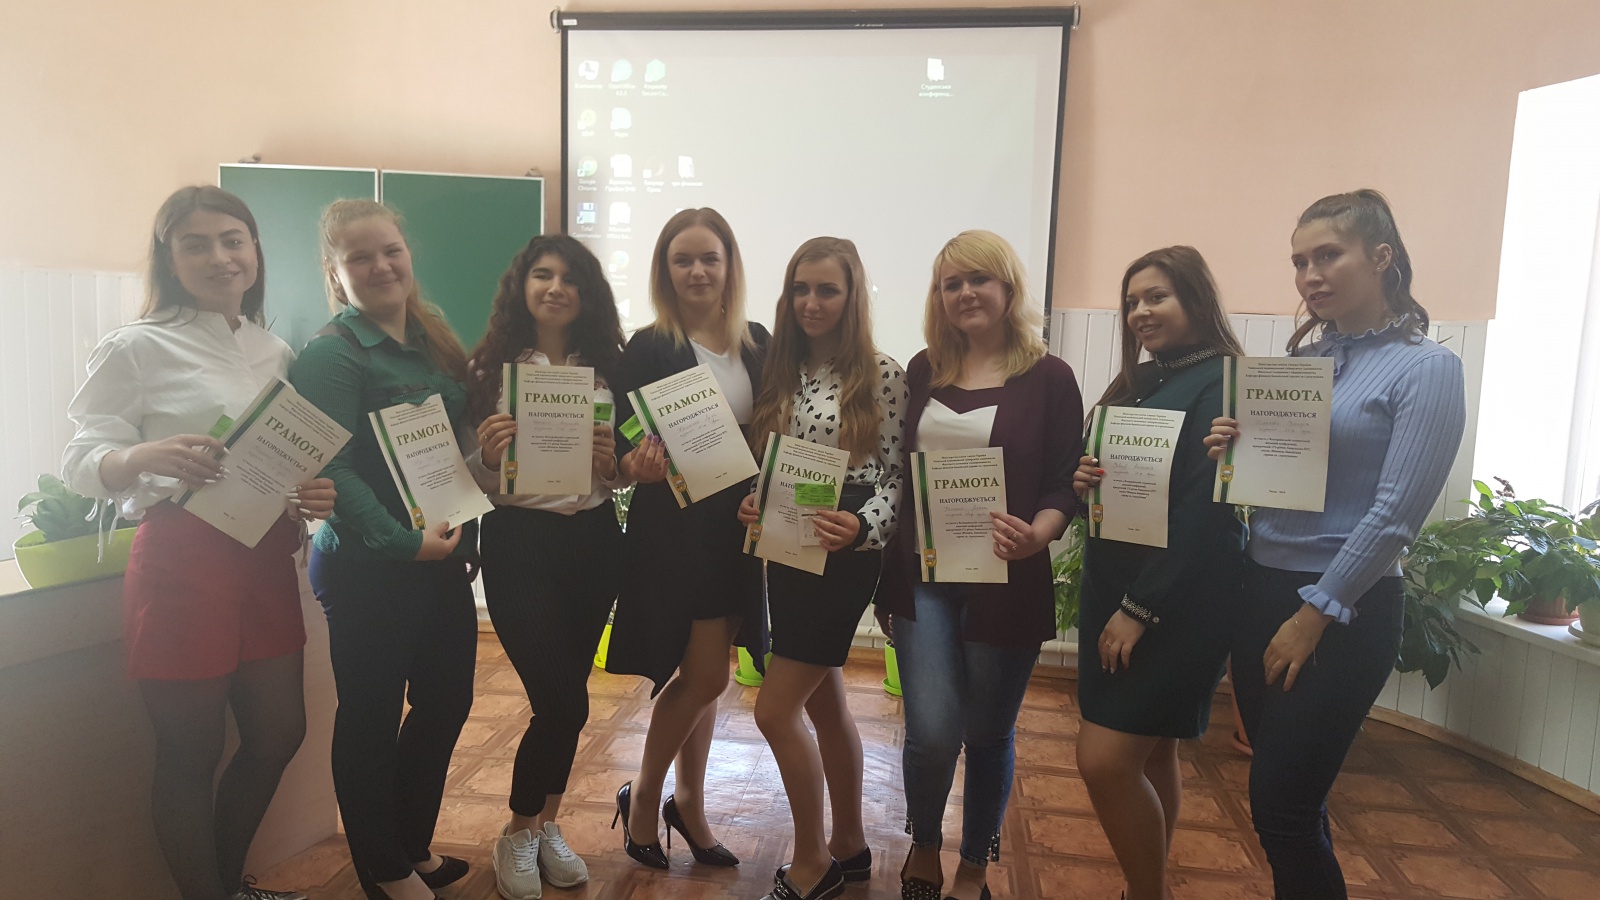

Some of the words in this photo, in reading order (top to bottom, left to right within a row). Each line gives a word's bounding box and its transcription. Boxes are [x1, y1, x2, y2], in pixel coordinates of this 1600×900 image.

[524, 392, 589, 405] ГРАМОТА
[657, 387, 717, 417] ГРАМОТА
[1246, 388, 1323, 402] ГРАМОТА
[528, 411, 585, 419] НАГОРОДЖУЄТЬСЯ
[668, 402, 720, 429] НАГОРОДЖУЄТЬСЯ
[1250, 410, 1317, 419] НАГОРОДЖУЄТЬСЯ
[264, 416, 325, 463] ГРАМОТА
[396, 422, 448, 446] ГРАМОТА
[1108, 434, 1170, 449] ГРАМОТА
[1110, 454, 1163, 463] НАГОРОДЖУЄТЬСЯ
[779, 462, 838, 487] ГРАМОТА
[934, 477, 1000, 489] ГРАМОТА
[939, 496, 996, 504] НАГОРОДЖУЄТЬСЯ
